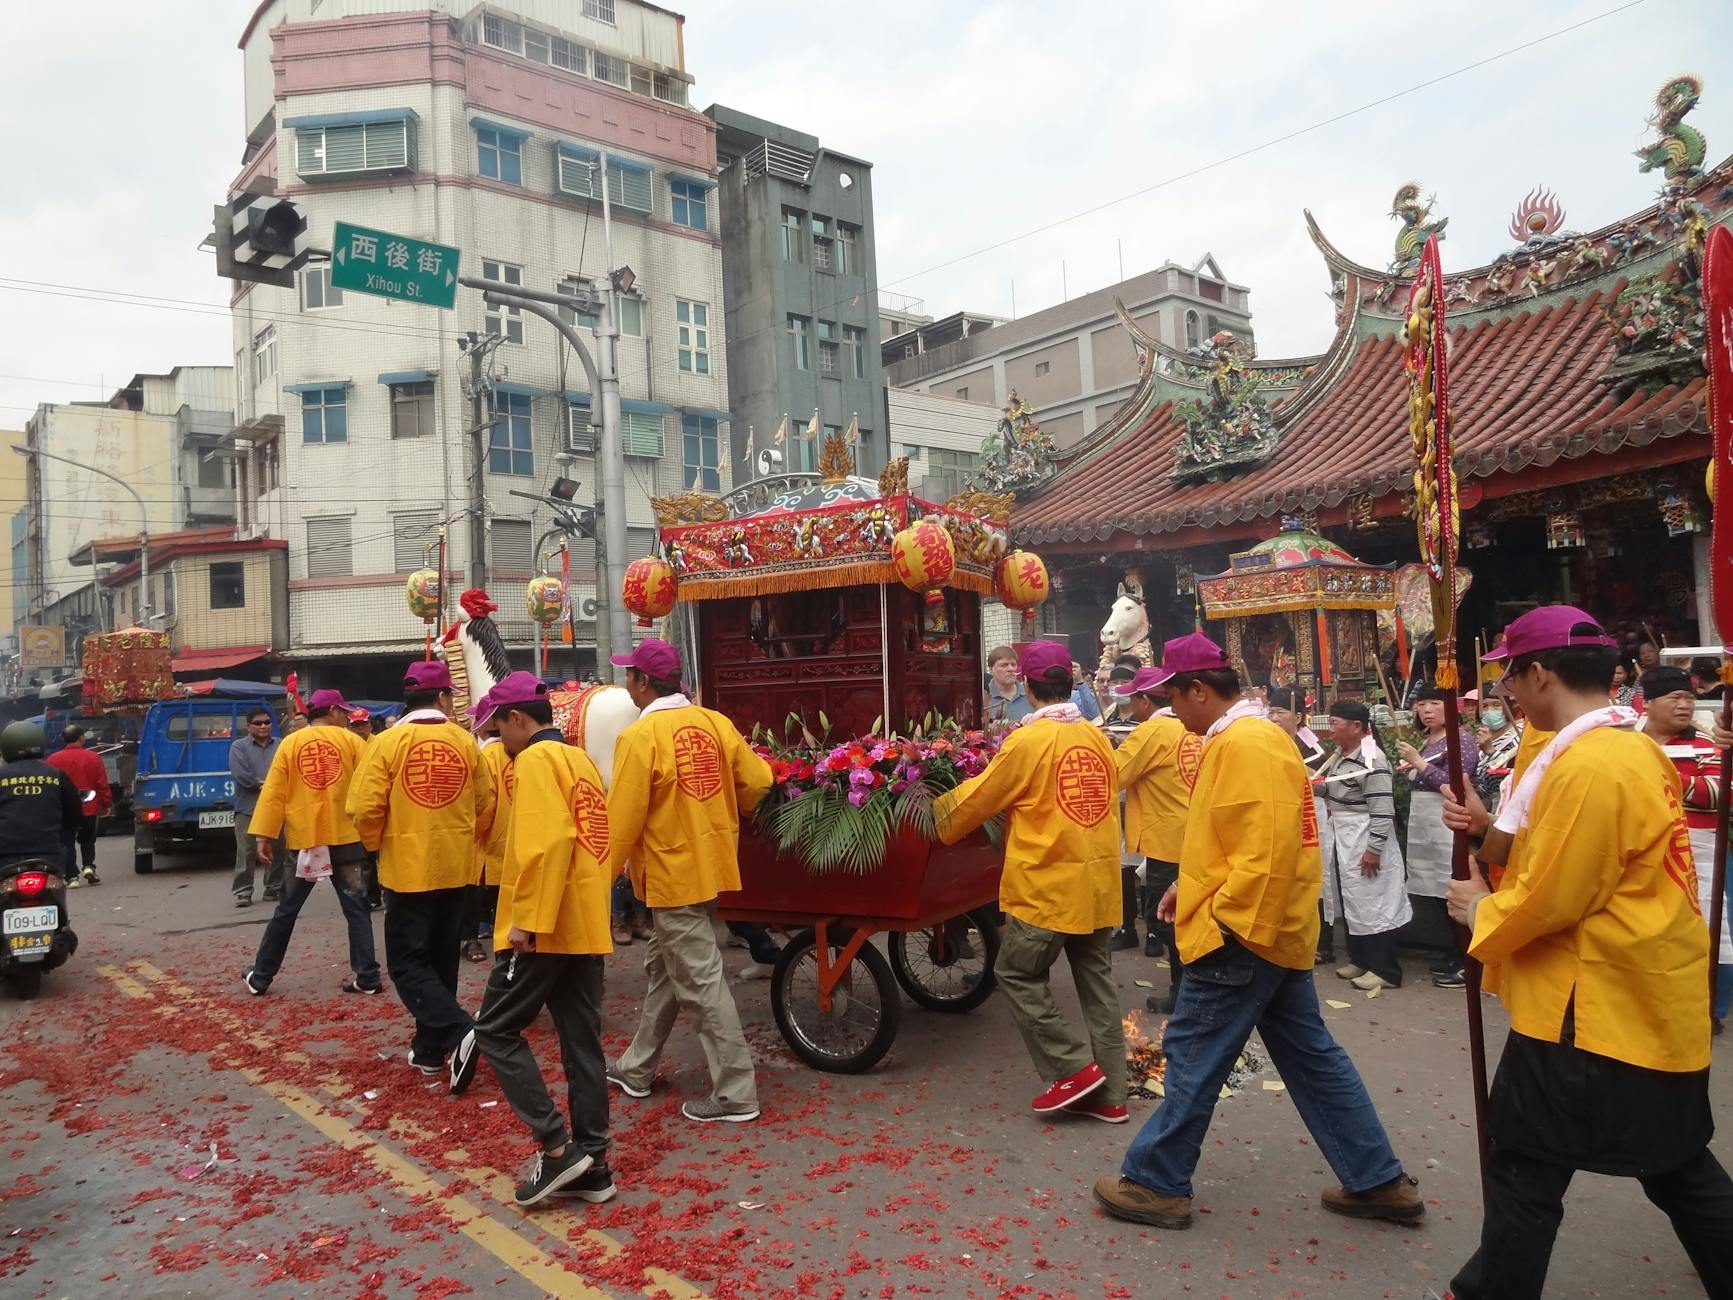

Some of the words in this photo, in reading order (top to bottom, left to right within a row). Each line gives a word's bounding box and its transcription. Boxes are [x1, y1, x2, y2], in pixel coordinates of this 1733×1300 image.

[350, 233, 443, 276] 西後街
[366, 272, 402, 294] Xihou
[406, 281, 424, 298] St.
[1018, 557, 1045, 590] 老
[13, 785, 43, 796] CID
